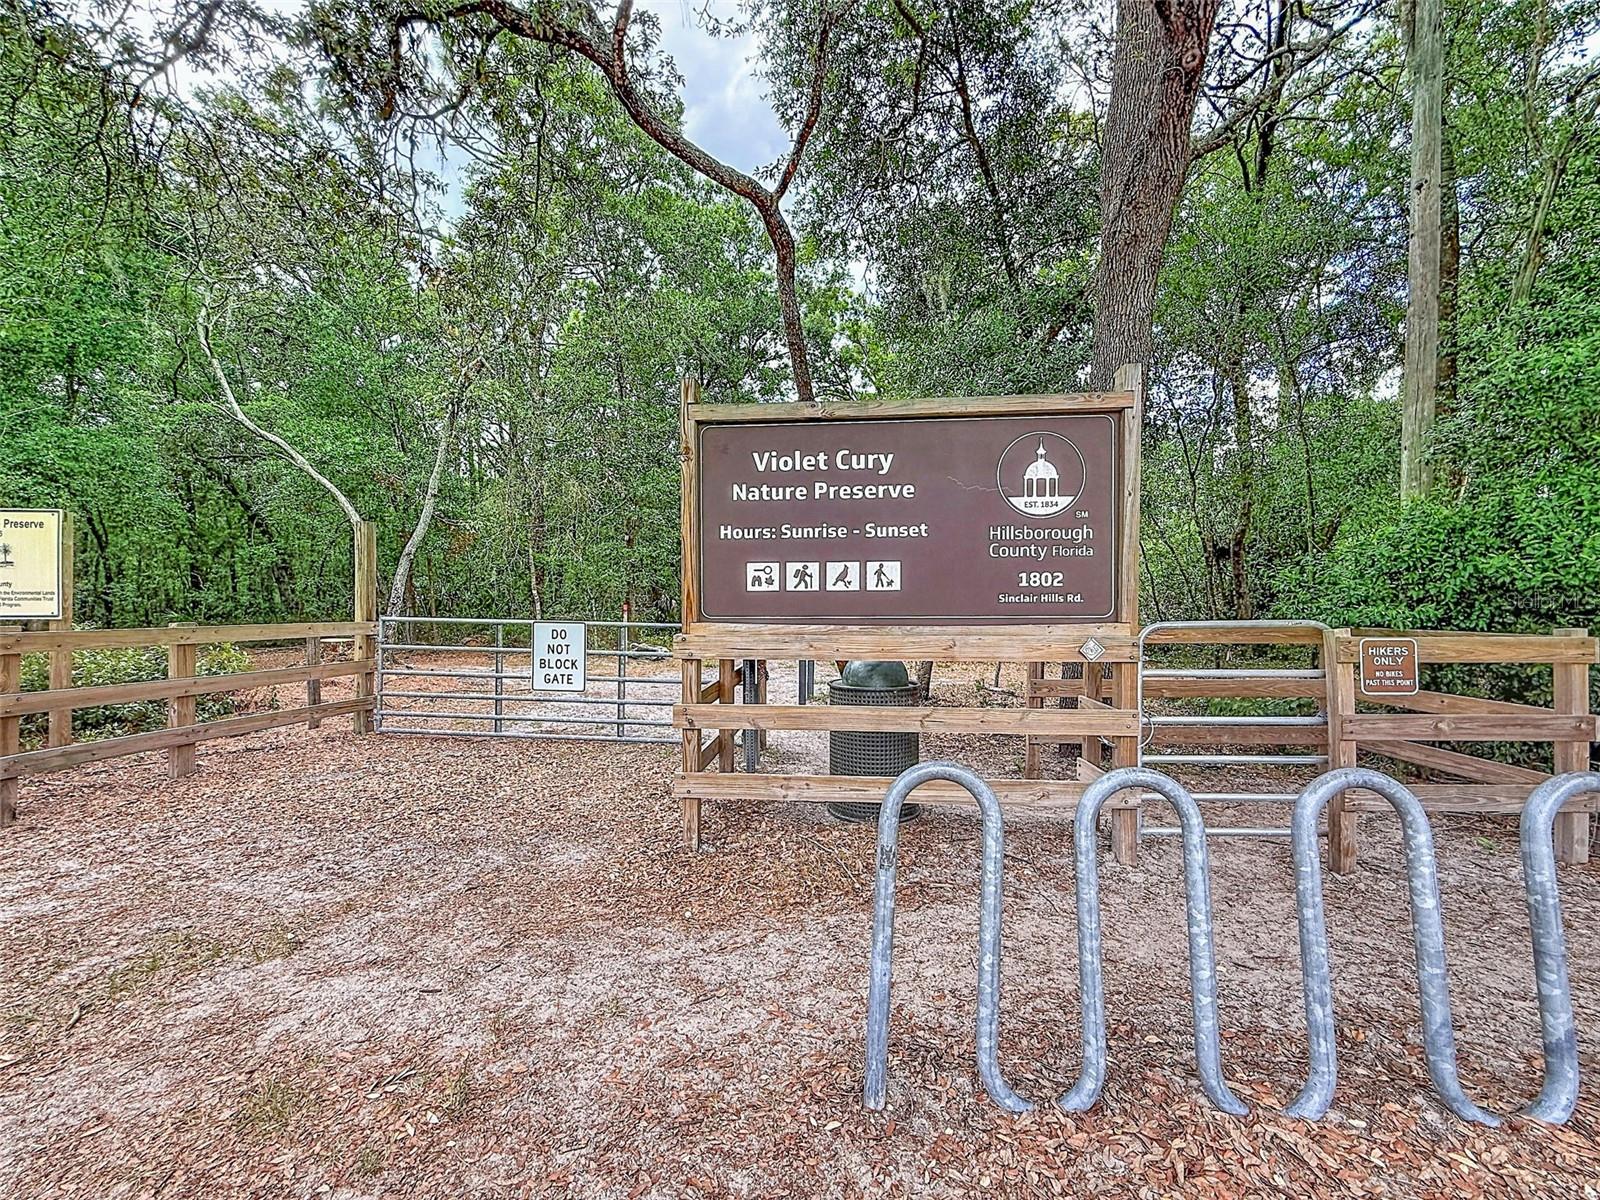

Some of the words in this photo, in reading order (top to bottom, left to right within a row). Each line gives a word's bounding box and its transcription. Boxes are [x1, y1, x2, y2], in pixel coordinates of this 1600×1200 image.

[752, 450, 829, 472] Violet
[836, 449, 894, 474] Cury
[732, 483, 808, 501] Nature
[814, 481, 916, 500] Preserve
[1075, 510, 1088, 518] SM
[3, 518, 45, 528] Preserve
[719, 525, 777, 540] Hours:
[780, 523, 848, 539] Sunrise
[865, 522, 929, 538] Sunset
[989, 524, 1093, 543] Hillsborough
[989, 543, 1048, 561] County
[1052, 544, 1094, 556] Florida
[1018, 572, 1064, 587] 1802
[998, 593, 1039, 603] Sinclair
[1040, 593, 1065, 603] Hills
[1067, 593, 1084, 602] Rd.
[551, 628, 567, 640] DO
[547, 643, 571, 655] NOT
[1368, 646, 1409, 656] HIKERS
[539, 658, 578, 670] BLOCK
[1373, 656, 1404, 666] ONLY
[544, 673, 573, 685] GATE
